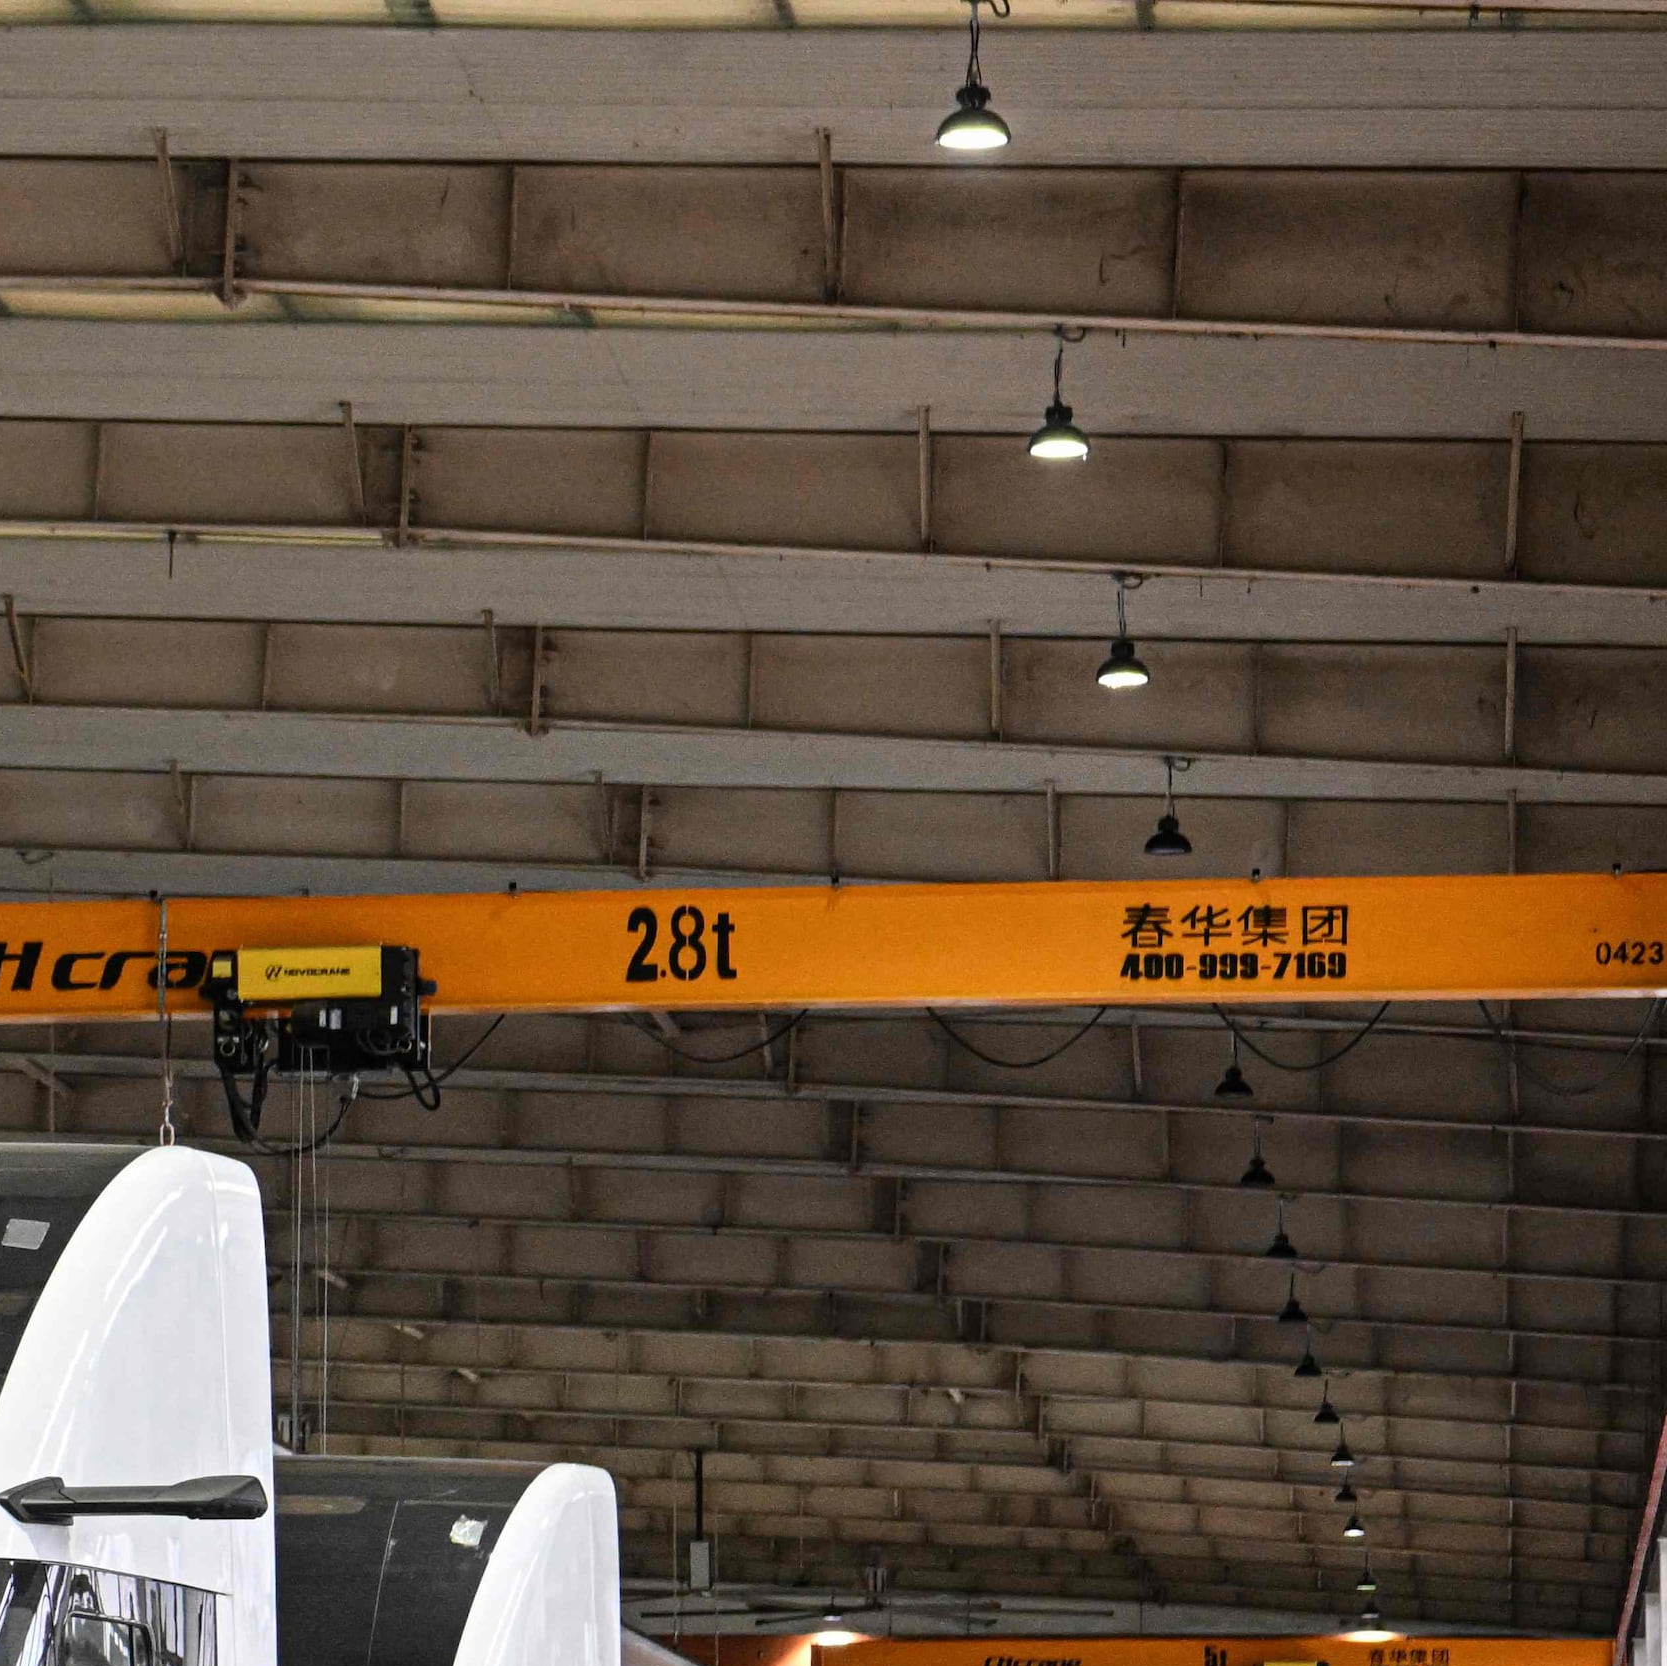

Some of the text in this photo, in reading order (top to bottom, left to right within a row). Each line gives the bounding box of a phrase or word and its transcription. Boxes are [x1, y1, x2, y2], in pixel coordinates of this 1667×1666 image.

[626, 904, 737, 982] 2.8t
[1120, 902, 1349, 948] 春华集团
[1120, 953, 1347, 980] 400-999-7169
[1596, 941, 1665, 966] 0423
